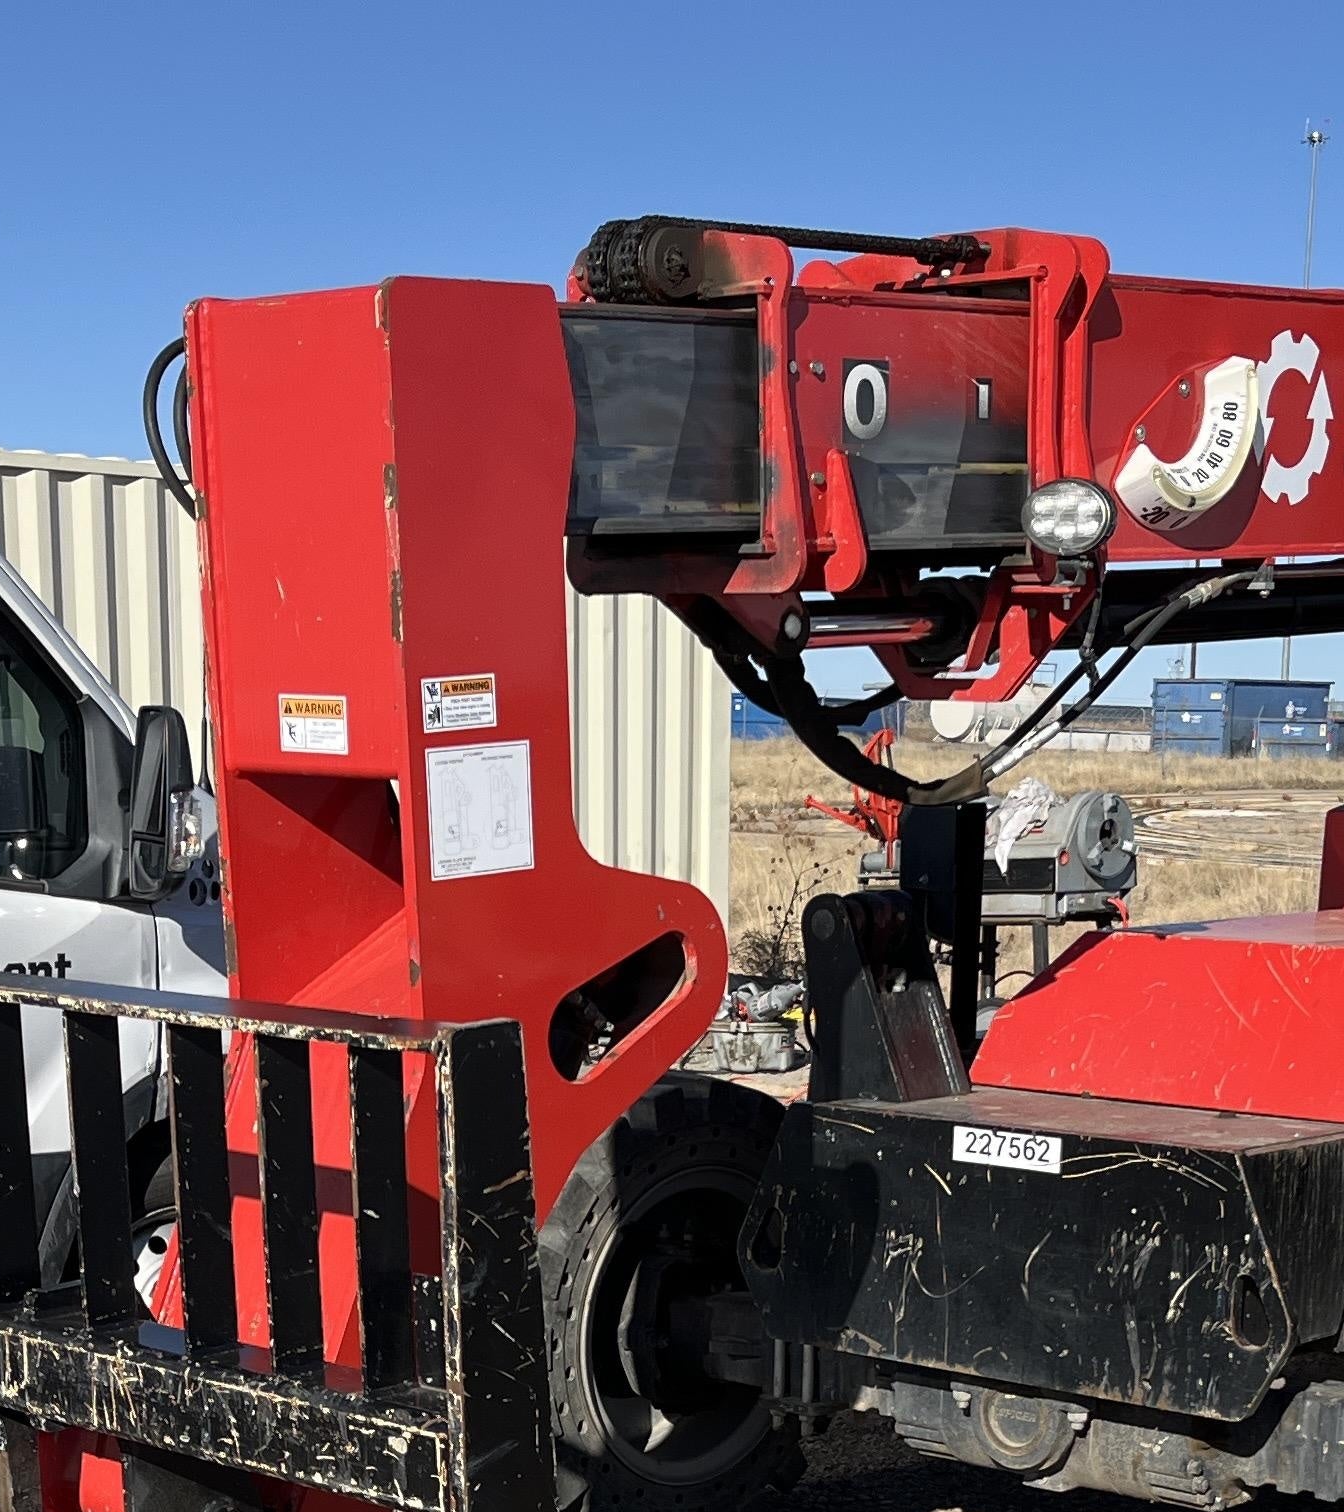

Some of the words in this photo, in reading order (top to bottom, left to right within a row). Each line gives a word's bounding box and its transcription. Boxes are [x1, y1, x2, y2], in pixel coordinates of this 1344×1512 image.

[1222, 401, 1239, 421] 80
[1215, 429, 1234, 448] 60
[1205, 452, 1224, 470] 40
[1191, 467, 1210, 484] 20
[452, 680, 490, 692] WARNING
[295, 702, 342, 715] WARNING
[965, 1131, 1050, 1164] 227562
